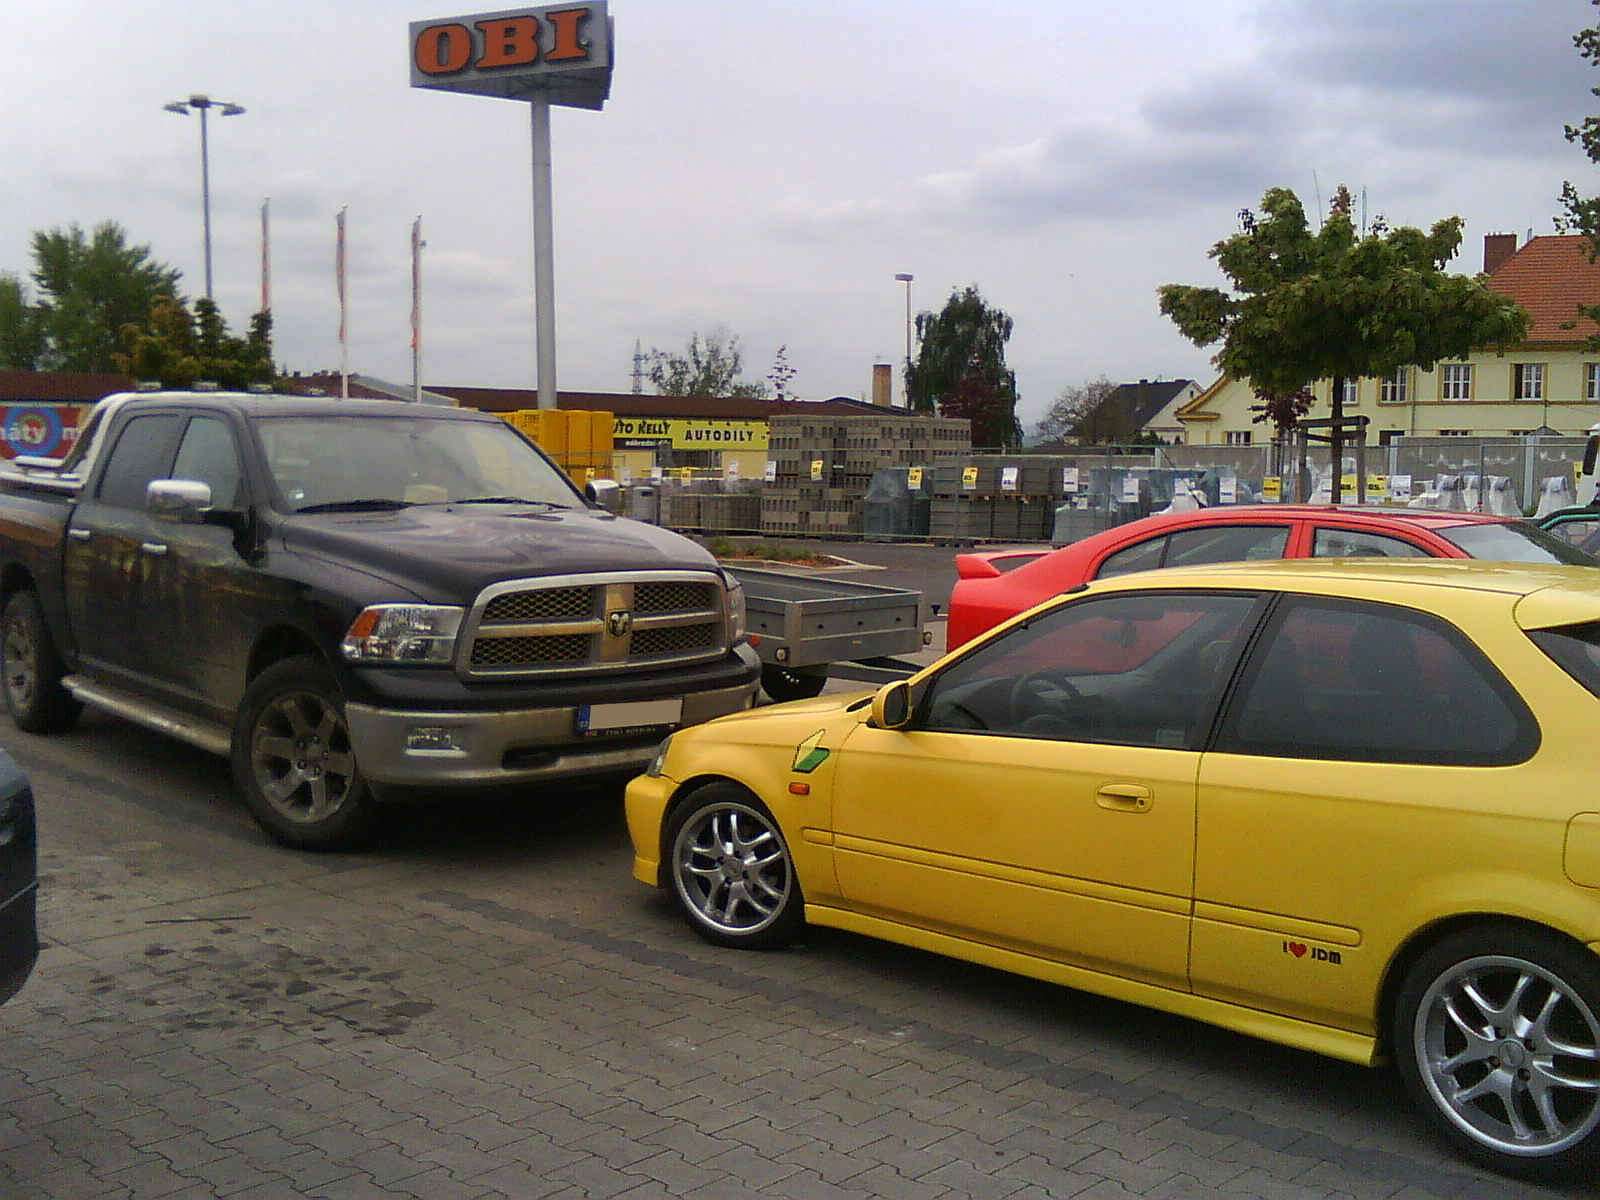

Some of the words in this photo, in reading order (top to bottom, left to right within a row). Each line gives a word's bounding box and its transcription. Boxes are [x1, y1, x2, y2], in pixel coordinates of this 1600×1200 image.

[414, 7, 589, 74] OBI
[638, 422, 671, 435] KELLY
[1283, 941, 1288, 952] I
